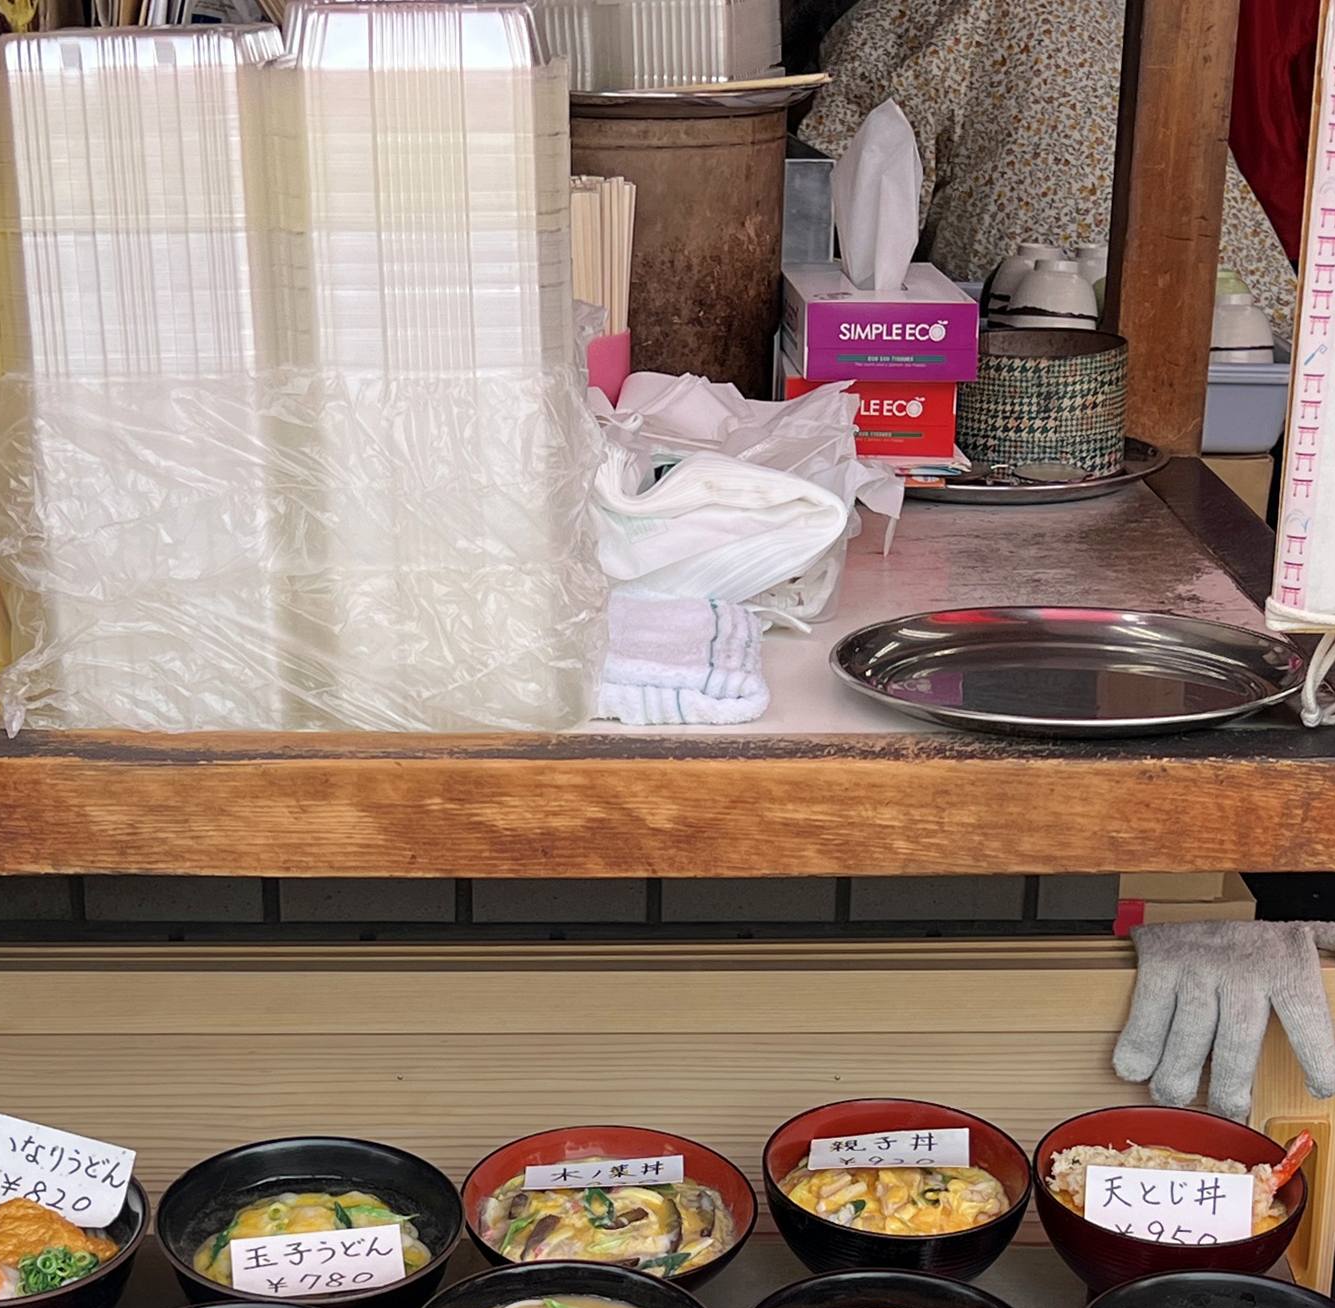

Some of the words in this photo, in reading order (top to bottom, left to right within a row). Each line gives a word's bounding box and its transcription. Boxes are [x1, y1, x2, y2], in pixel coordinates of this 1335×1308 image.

[839, 323, 902, 341] SIMPLE
[905, 320, 948, 342] ECO
[883, 397, 925, 418] ECO
[830, 1132, 938, 1152] 親子丼
[1, 1173, 92, 1212] ¥820
[1102, 1175, 1226, 1216] 天とじ丼
[243, 1236, 393, 1270] 玉子うどん
[266, 1271, 374, 1293] ¥780
